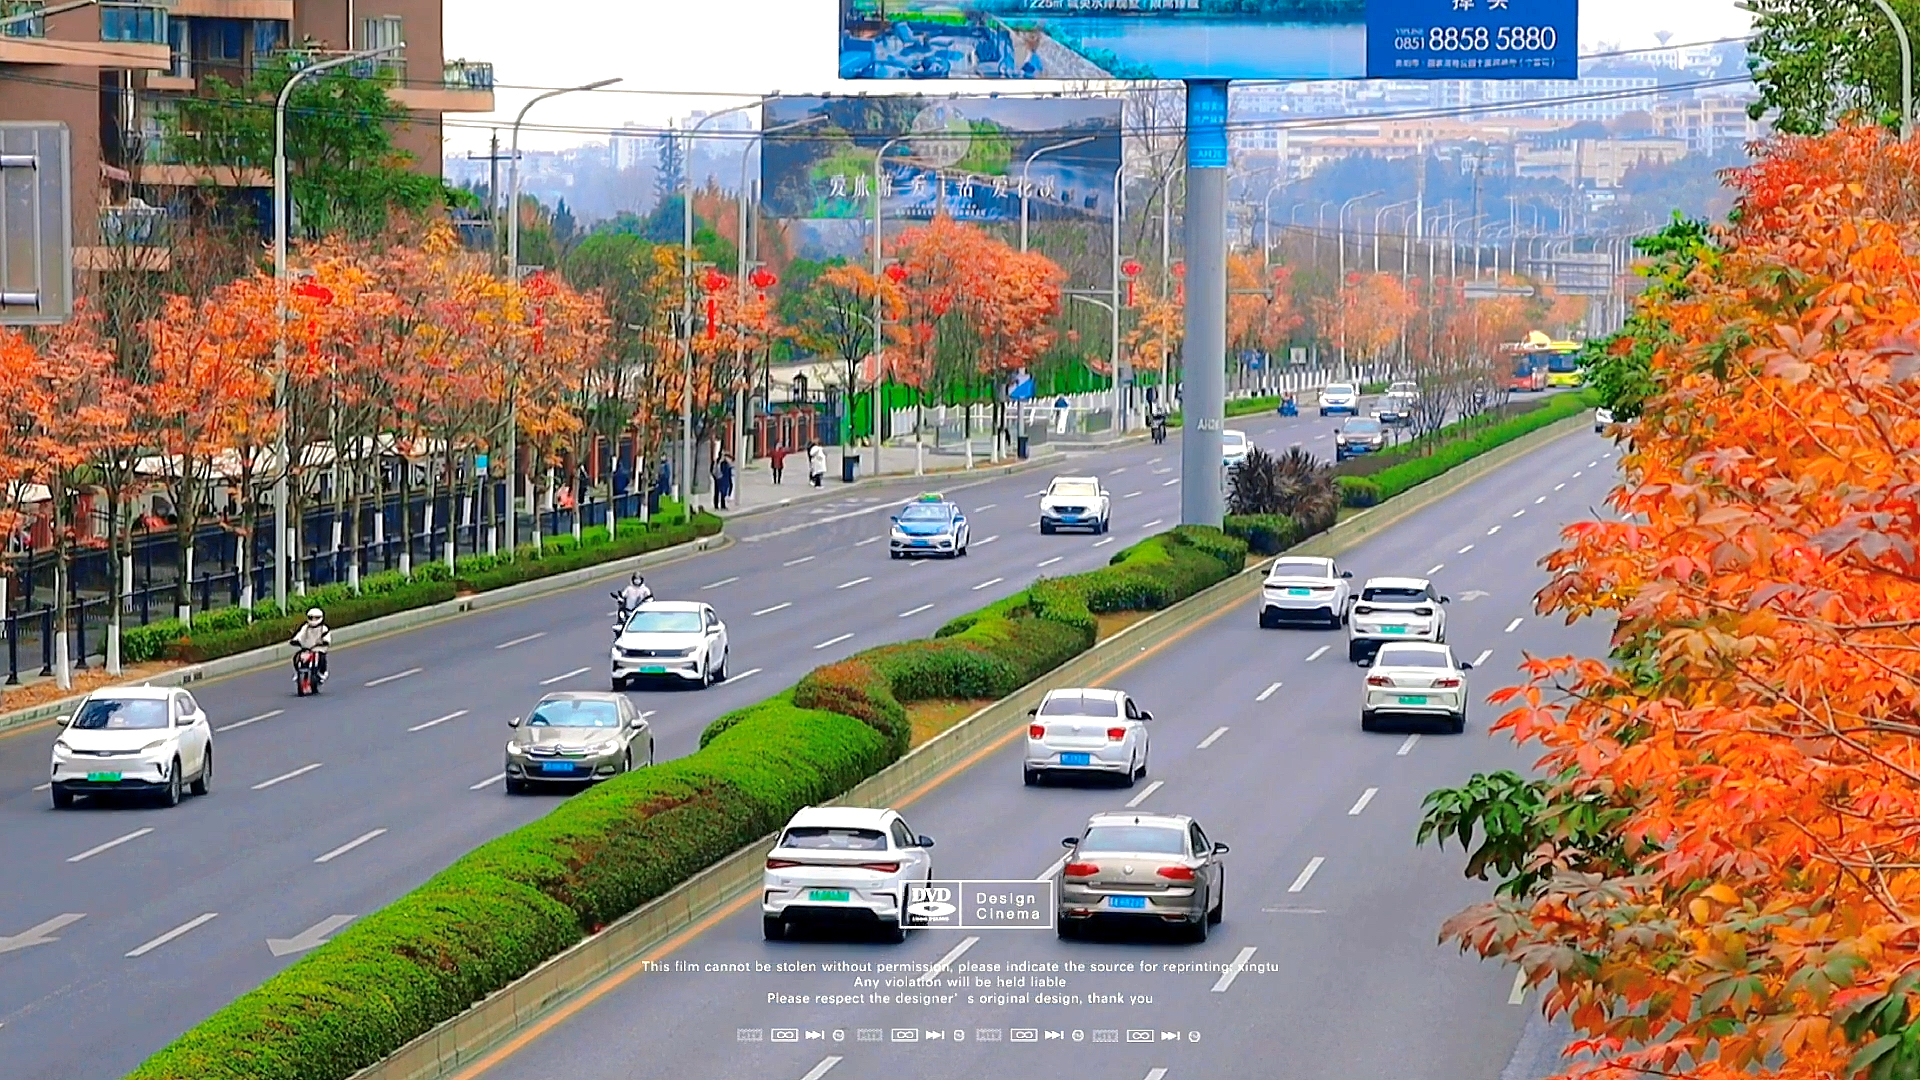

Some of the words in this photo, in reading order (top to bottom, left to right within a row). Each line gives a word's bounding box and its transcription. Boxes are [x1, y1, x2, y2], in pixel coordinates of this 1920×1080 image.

[1394, 36, 1425, 50] 0851
[1429, 26, 1489, 51] 8858
[1496, 26, 1556, 51] 5880
